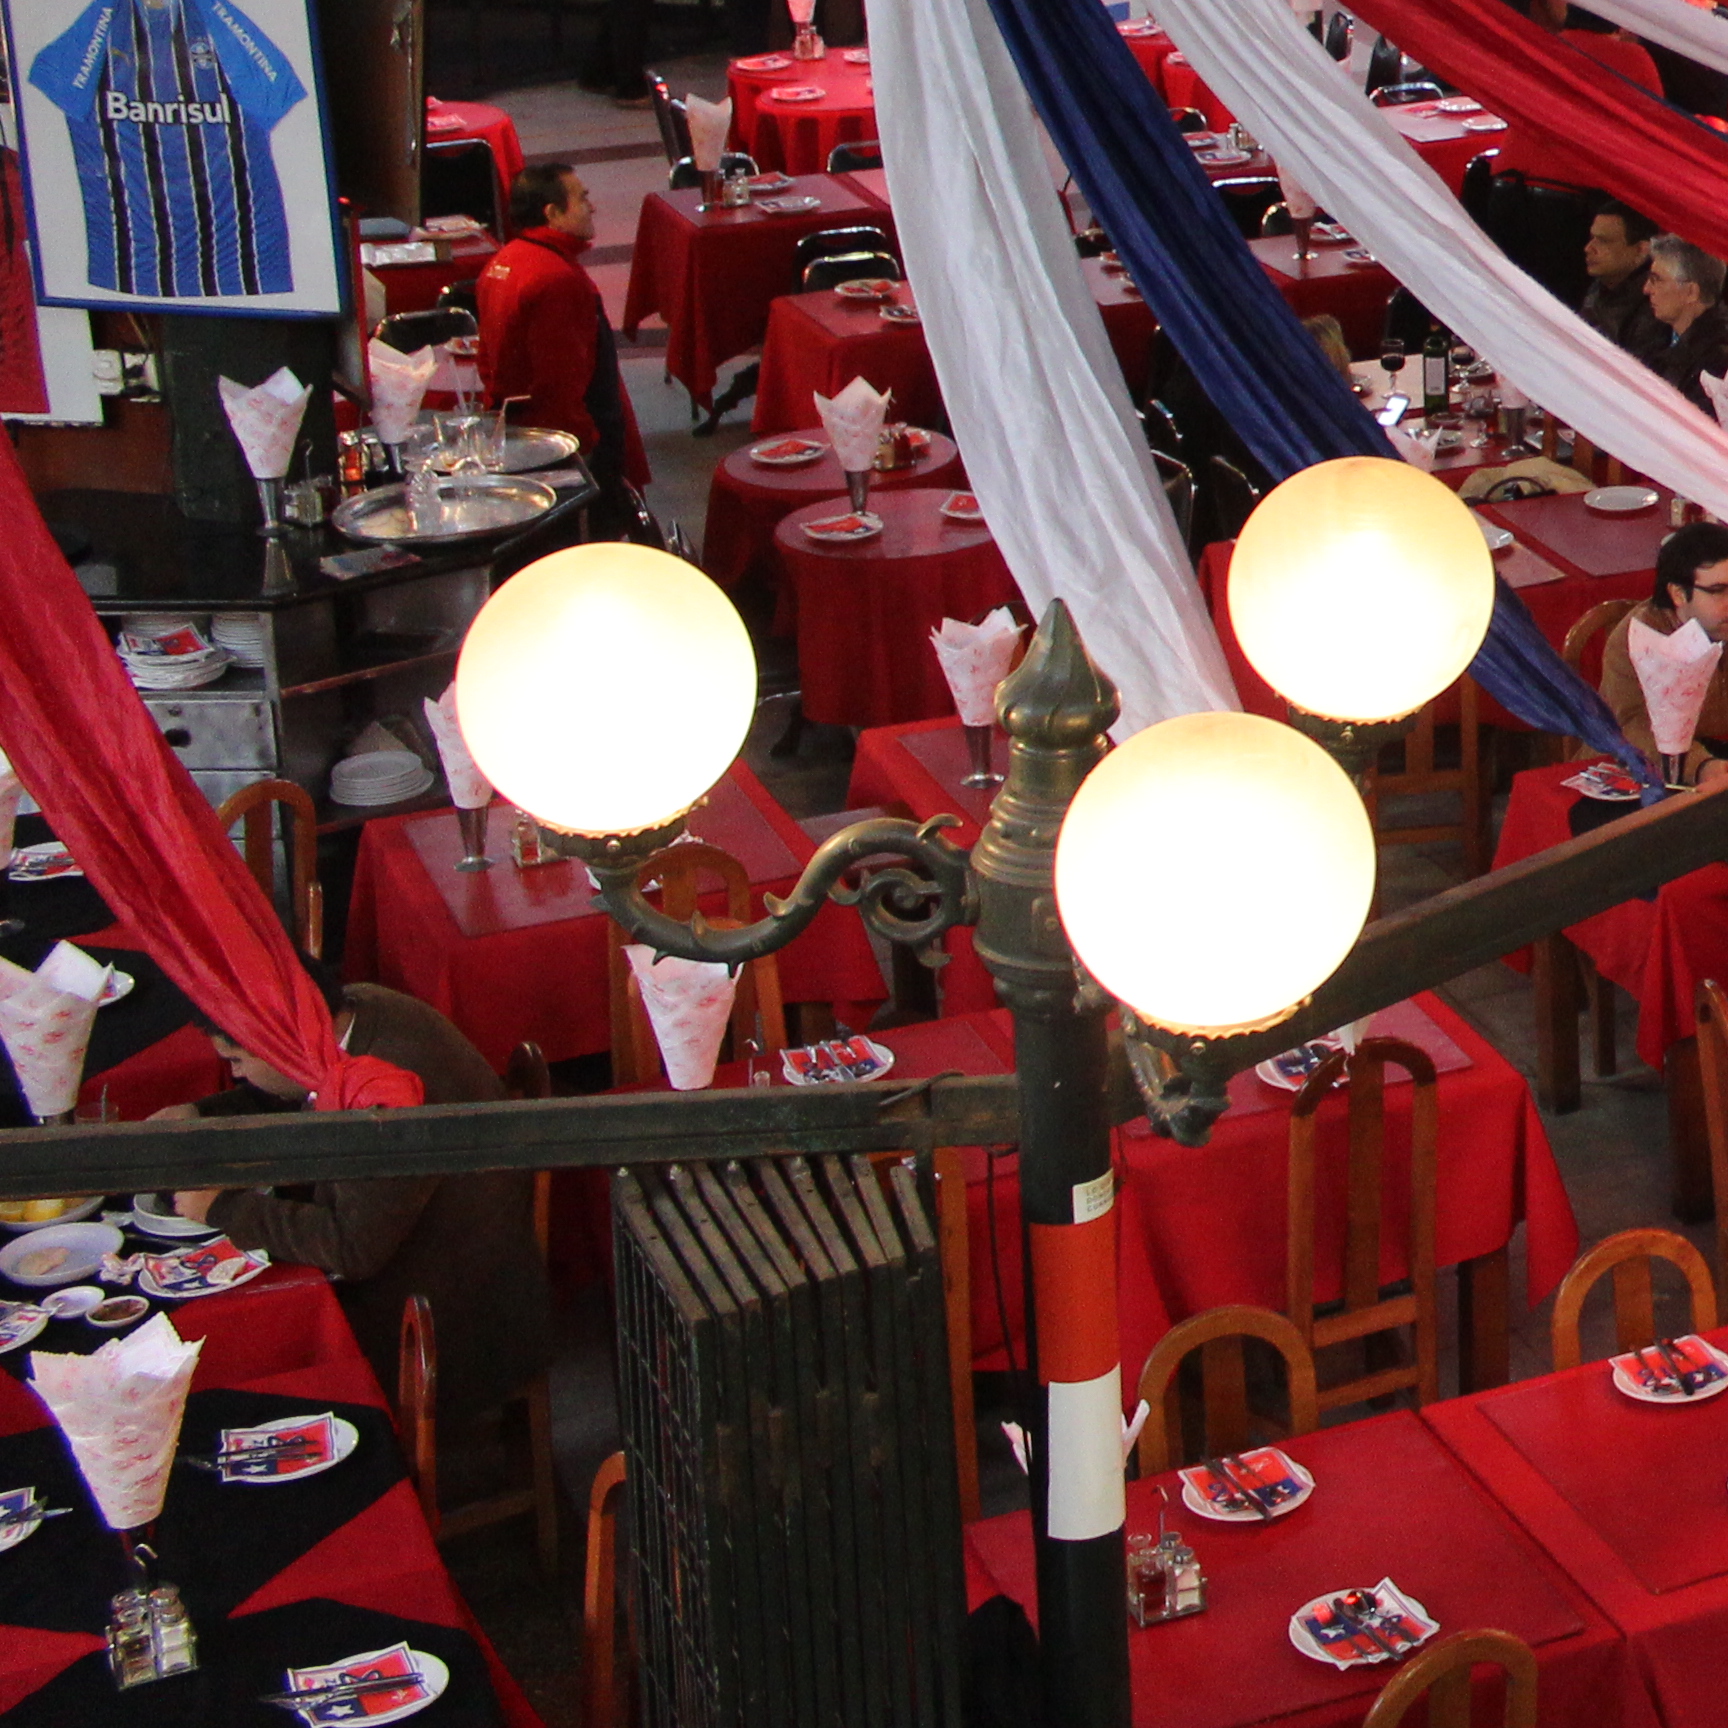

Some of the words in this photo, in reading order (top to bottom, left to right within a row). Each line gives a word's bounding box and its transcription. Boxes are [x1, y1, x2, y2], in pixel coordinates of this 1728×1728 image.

[72, 7, 114, 91] TRAMONTINA
[211, 0, 279, 84] TRAMONTINA
[105, 90, 231, 126] Banrisul
